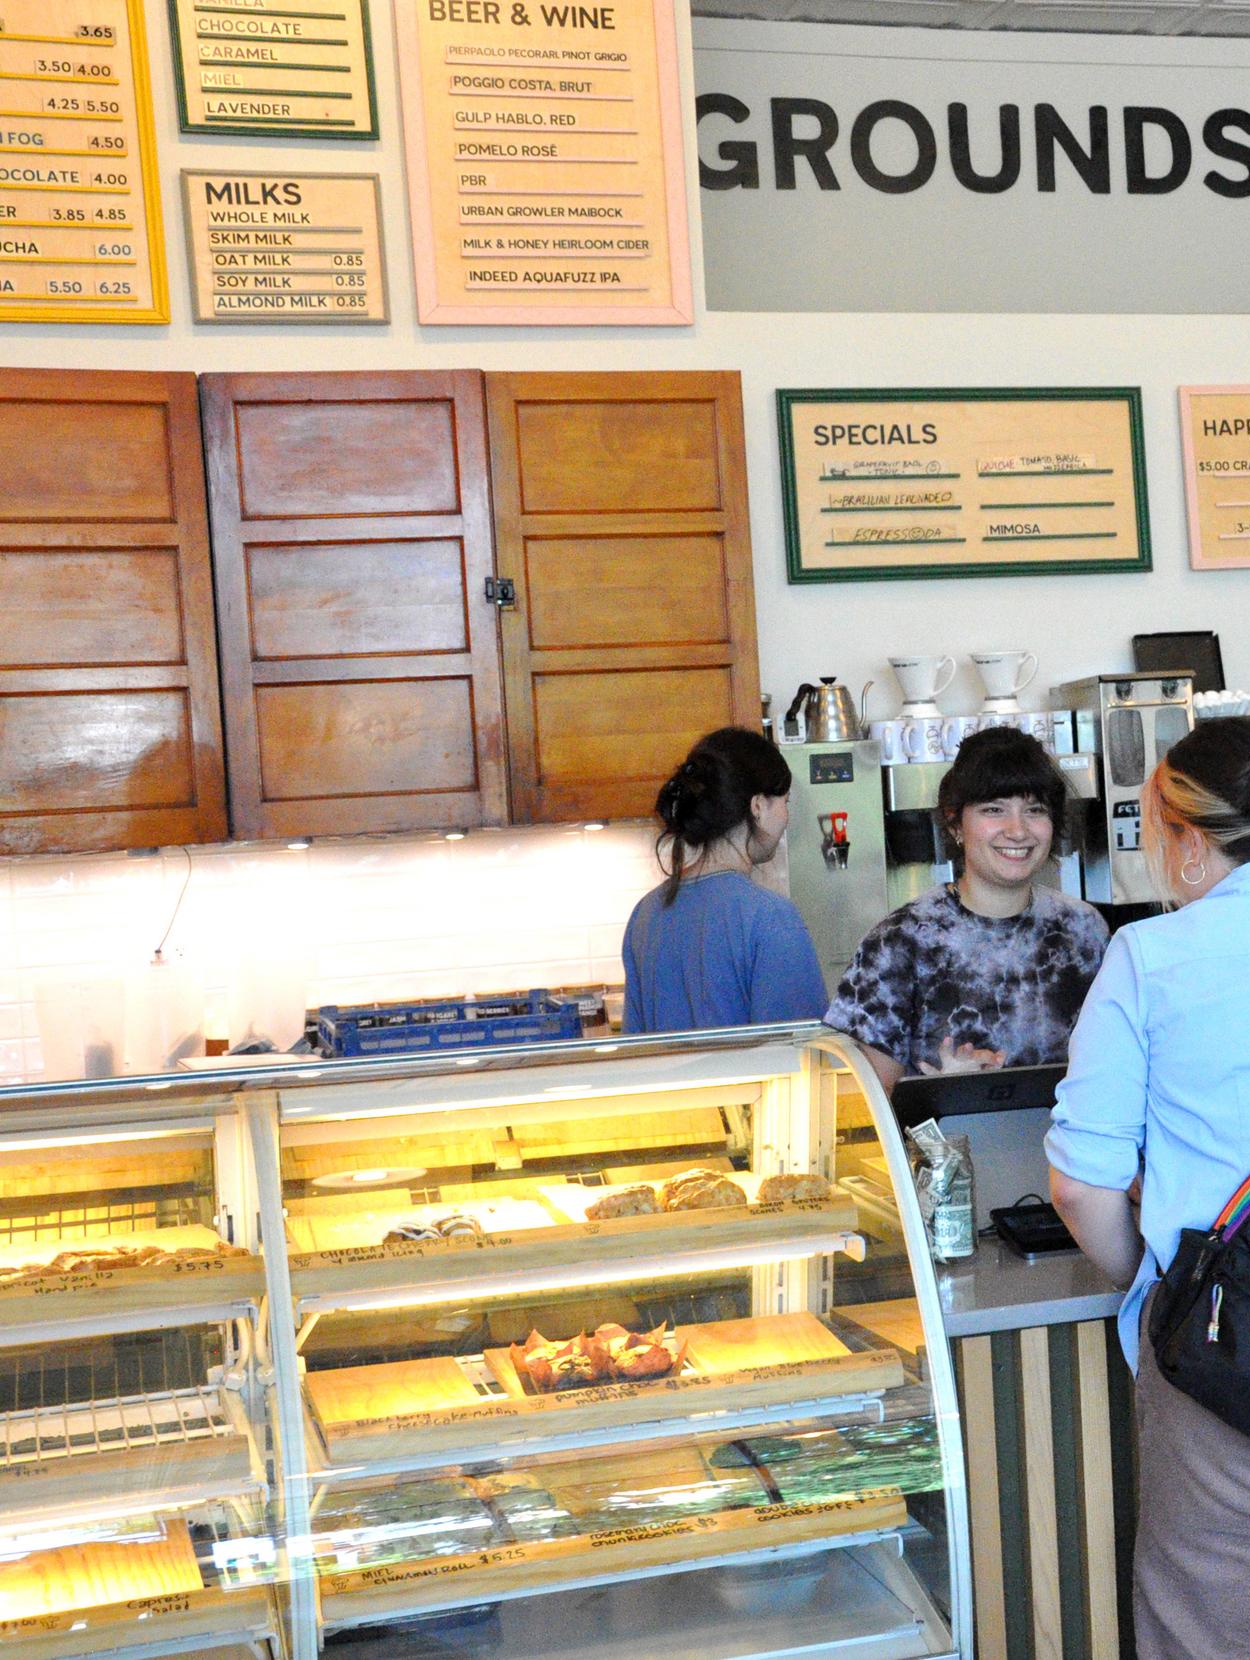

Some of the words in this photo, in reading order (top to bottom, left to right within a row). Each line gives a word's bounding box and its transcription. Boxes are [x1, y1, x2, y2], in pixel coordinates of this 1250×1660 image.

[429, 0, 500, 24] BEER
[510, 2, 531, 26] &
[540, 4, 616, 30] WINE
[80, 26, 113, 38] 3.65
[198, 18, 302, 36] CHOCOLATE
[200, 45, 278, 61] CARAMEL
[448, 46, 505, 58] PIERPAOLO
[562, 50, 591, 61] PINOT
[594, 52, 627, 62] GRIGIO
[38, 60, 71, 73] 3.50
[77, 65, 111, 77] 4.00
[203, 73, 241, 86] MIEL
[453, 76, 505, 89] POGGIO
[559, 81, 593, 93] BRUT
[47, 98, 80, 111] 4.25
[87, 101, 119, 113] 5.50
[207, 101, 290, 116] LAVENDER
[455, 111, 491, 123] GULP
[550, 114, 576, 126] RED
[8, 132, 44, 146] FOG
[91, 137, 124, 149] 4.50
[458, 143, 518, 156] POMELO
[94, 173, 127, 185] 4.00
[461, 174, 487, 186] PBR
[205, 181, 302, 206] MILKS
[53, 208, 85, 221] 3.85
[95, 208, 126, 221] 4.85
[211, 211, 269, 223] WHOLE
[273, 212, 311, 224] MILK
[461, 206, 504, 217] URBAN
[507, 206, 565, 218] GROWLER
[568, 207, 623, 218] MAIBOCK
[211, 232, 250, 244] SKIM
[255, 233, 292, 245] MILK
[463, 238, 491, 249] MILK
[496, 238, 505, 249] &
[508, 239, 549, 249] HONEY
[553, 239, 614, 249] HEIRLOOM
[617, 239, 649, 249] CIDER
[98, 244, 131, 256] 6.00
[215, 254, 248, 266] OAT
[253, 254, 291, 266] MILK
[333, 255, 363, 266] 0.85
[217, 275, 248, 288] SOY
[254, 276, 292, 288] MILK
[335, 275, 365, 286] 0.85
[469, 271, 518, 282] INDEED
[522, 271, 596, 284] AQUAFUZZ
[600, 272, 621, 283] IPA
[49, 281, 82, 293] 5.50
[100, 282, 131, 294] 6.25
[216, 296, 286, 308] ALMOND
[290, 296, 327, 308] MILK
[336, 296, 366, 307] 0.85
[813, 423, 938, 446] SPECIALS
[1199, 461, 1230, 472] $5.00
[989, 523, 1041, 535] MIMOSA
